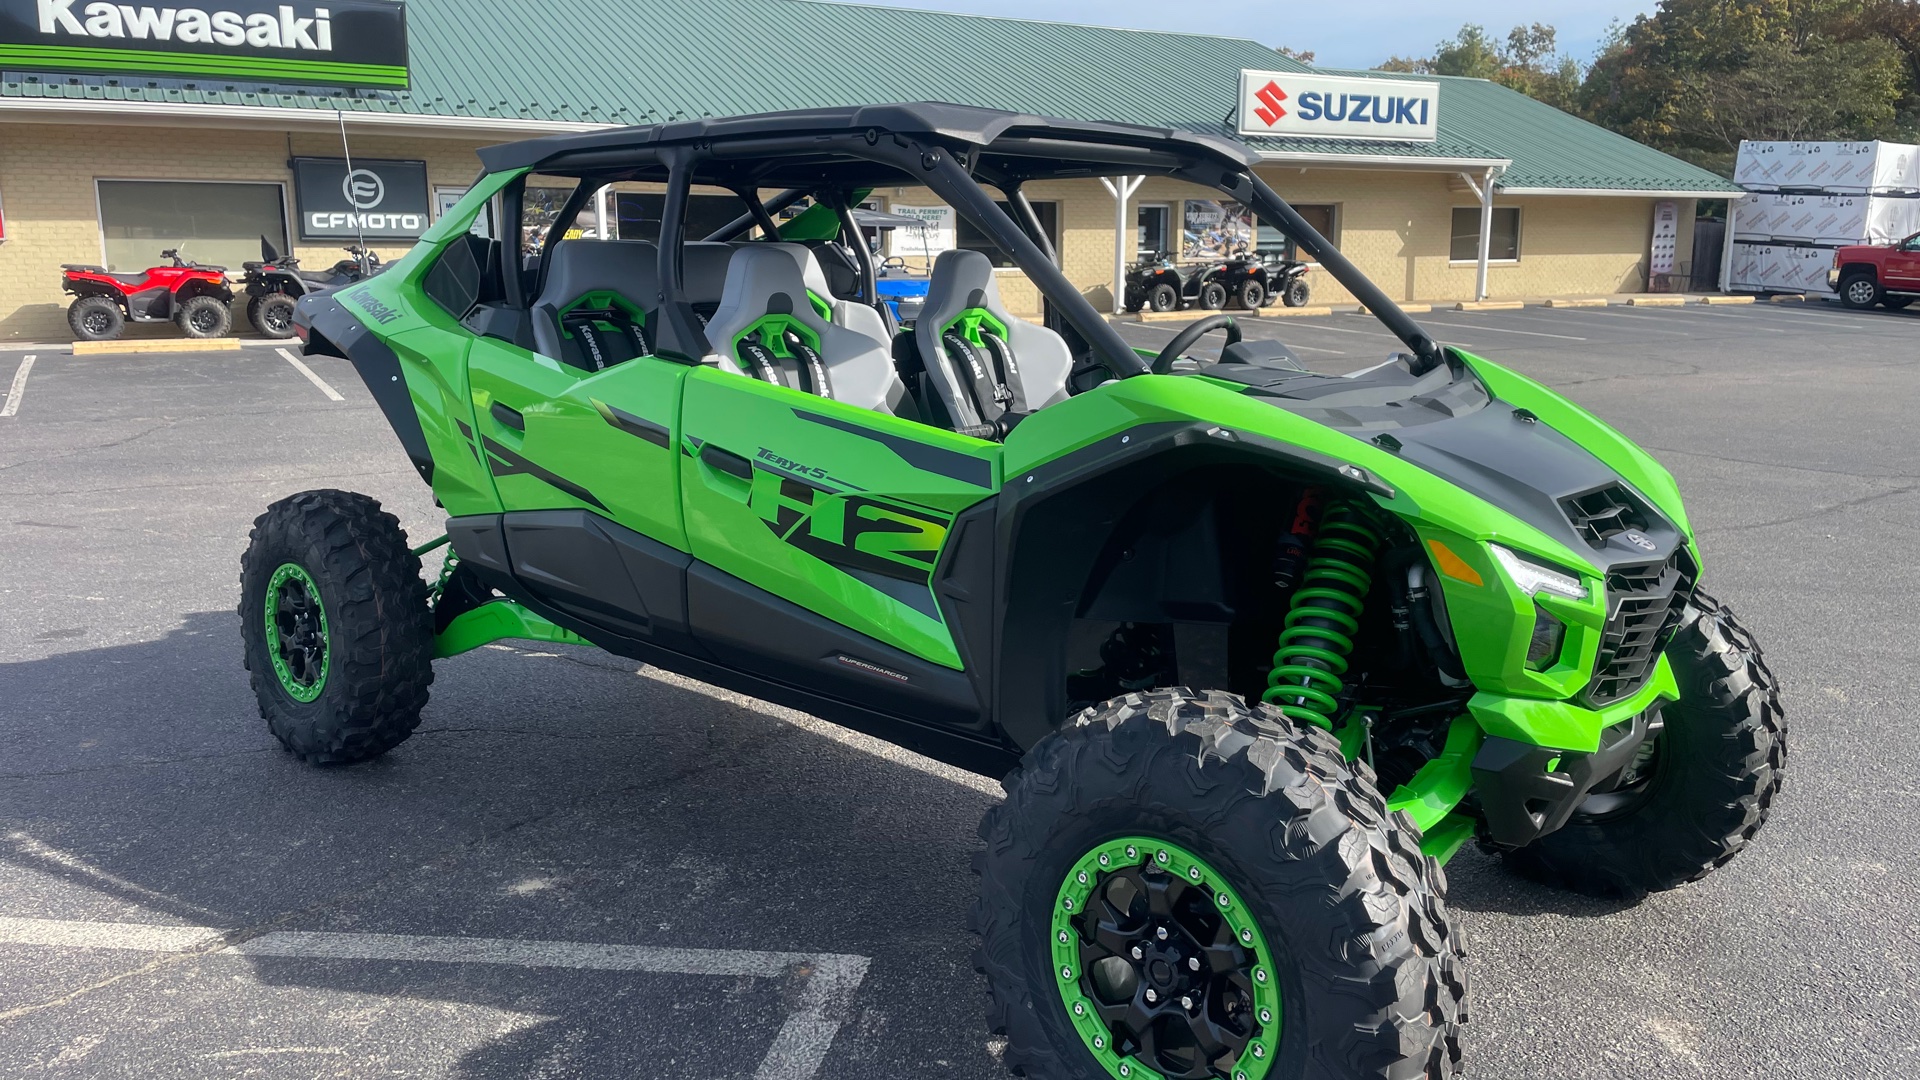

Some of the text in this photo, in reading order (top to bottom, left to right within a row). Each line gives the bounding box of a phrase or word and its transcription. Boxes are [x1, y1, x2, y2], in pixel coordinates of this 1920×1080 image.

[38, 0, 333, 51] Kawasaki
[1297, 91, 1429, 125] SUZUKI
[311, 213, 420, 230] CFMOTO
[562, 229, 583, 240] EADY
[347, 285, 403, 326] Kawasaki
[579, 324, 605, 369] Kawasa
[747, 345, 780, 387] Kawasa
[943, 334, 984, 380] Kawasaki
[801, 345, 830, 400] Kawasak
[838, 656, 909, 681] SUPERCHARGED
